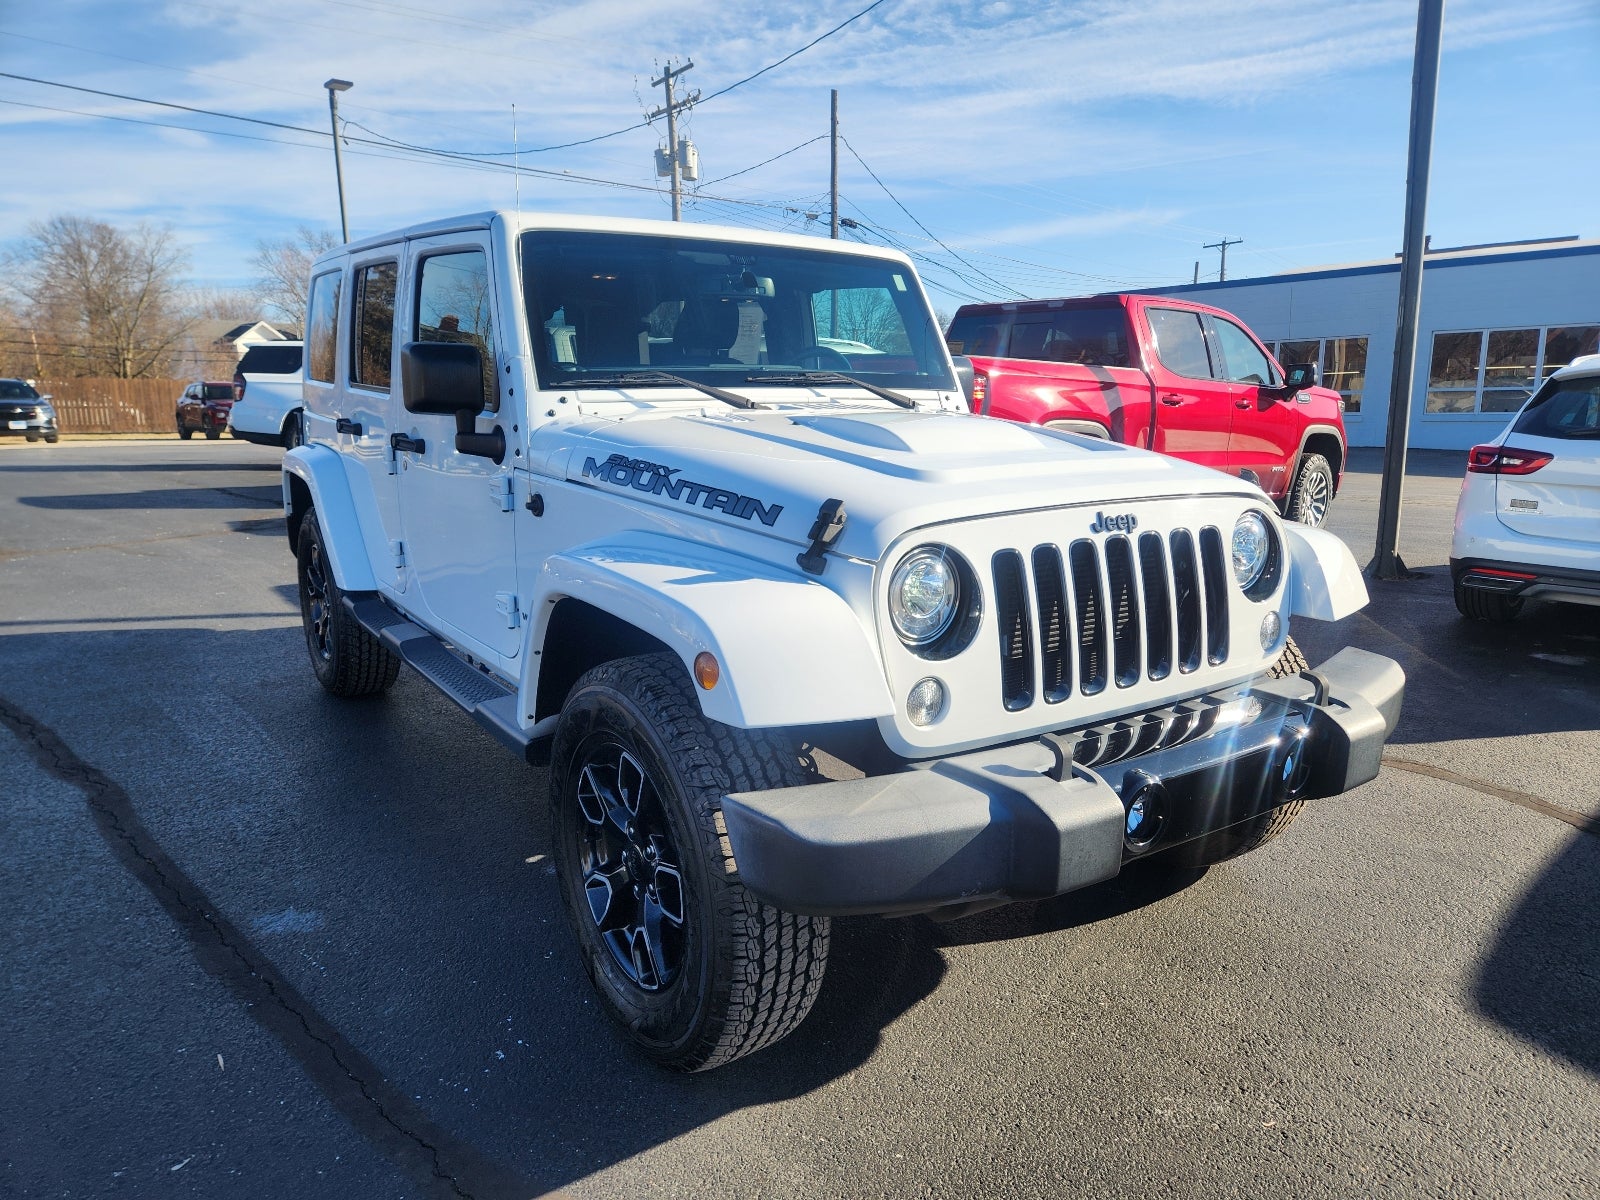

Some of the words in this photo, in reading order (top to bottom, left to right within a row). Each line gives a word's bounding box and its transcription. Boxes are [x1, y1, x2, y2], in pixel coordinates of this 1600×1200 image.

[607, 453, 682, 476] SMOKY
[581, 456, 784, 527] MOUNTAIN
[1089, 511, 1138, 534] Jeep
